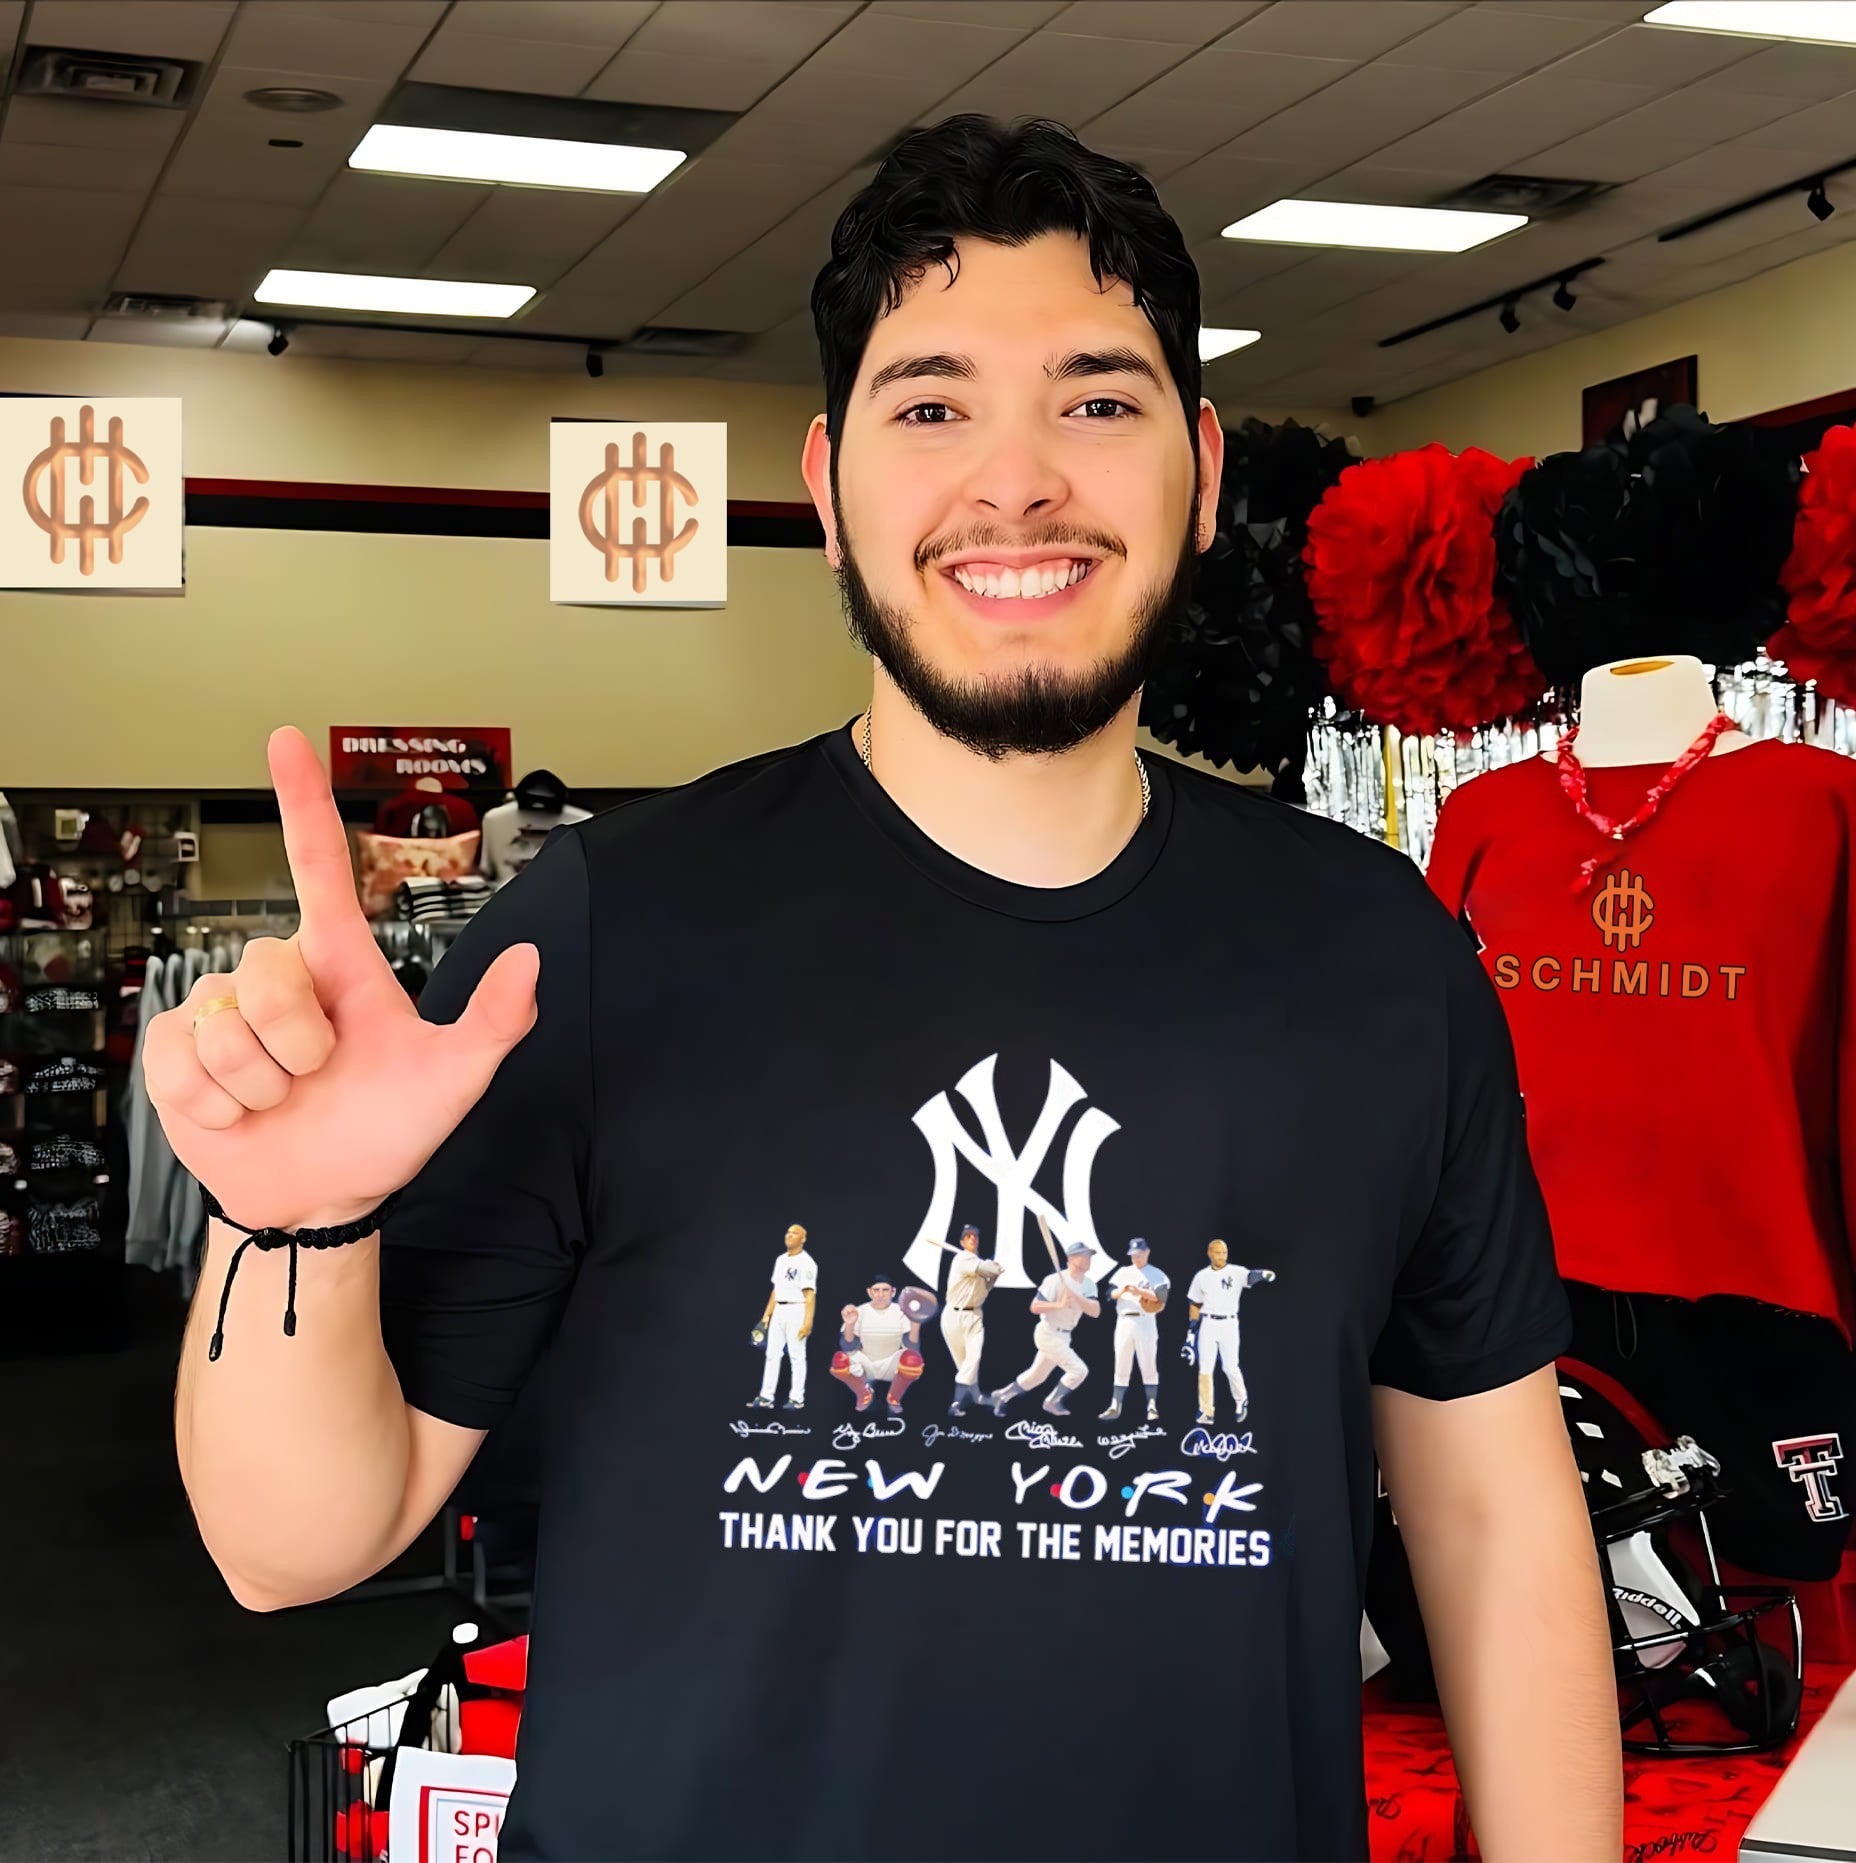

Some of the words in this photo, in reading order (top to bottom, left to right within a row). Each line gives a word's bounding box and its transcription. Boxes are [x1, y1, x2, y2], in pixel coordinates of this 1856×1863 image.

[342, 737, 467, 753] DRESSING
[396, 758, 487, 775] ROOMS
[1494, 954, 1746, 1000] SCHMIDT
[719, 1511, 838, 1552] THANK
[852, 1516, 923, 1555] YOU
[935, 1519, 1001, 1557] FOR
[1016, 1521, 1082, 1560] THE
[1093, 1524, 1271, 1567] MEMORIES
